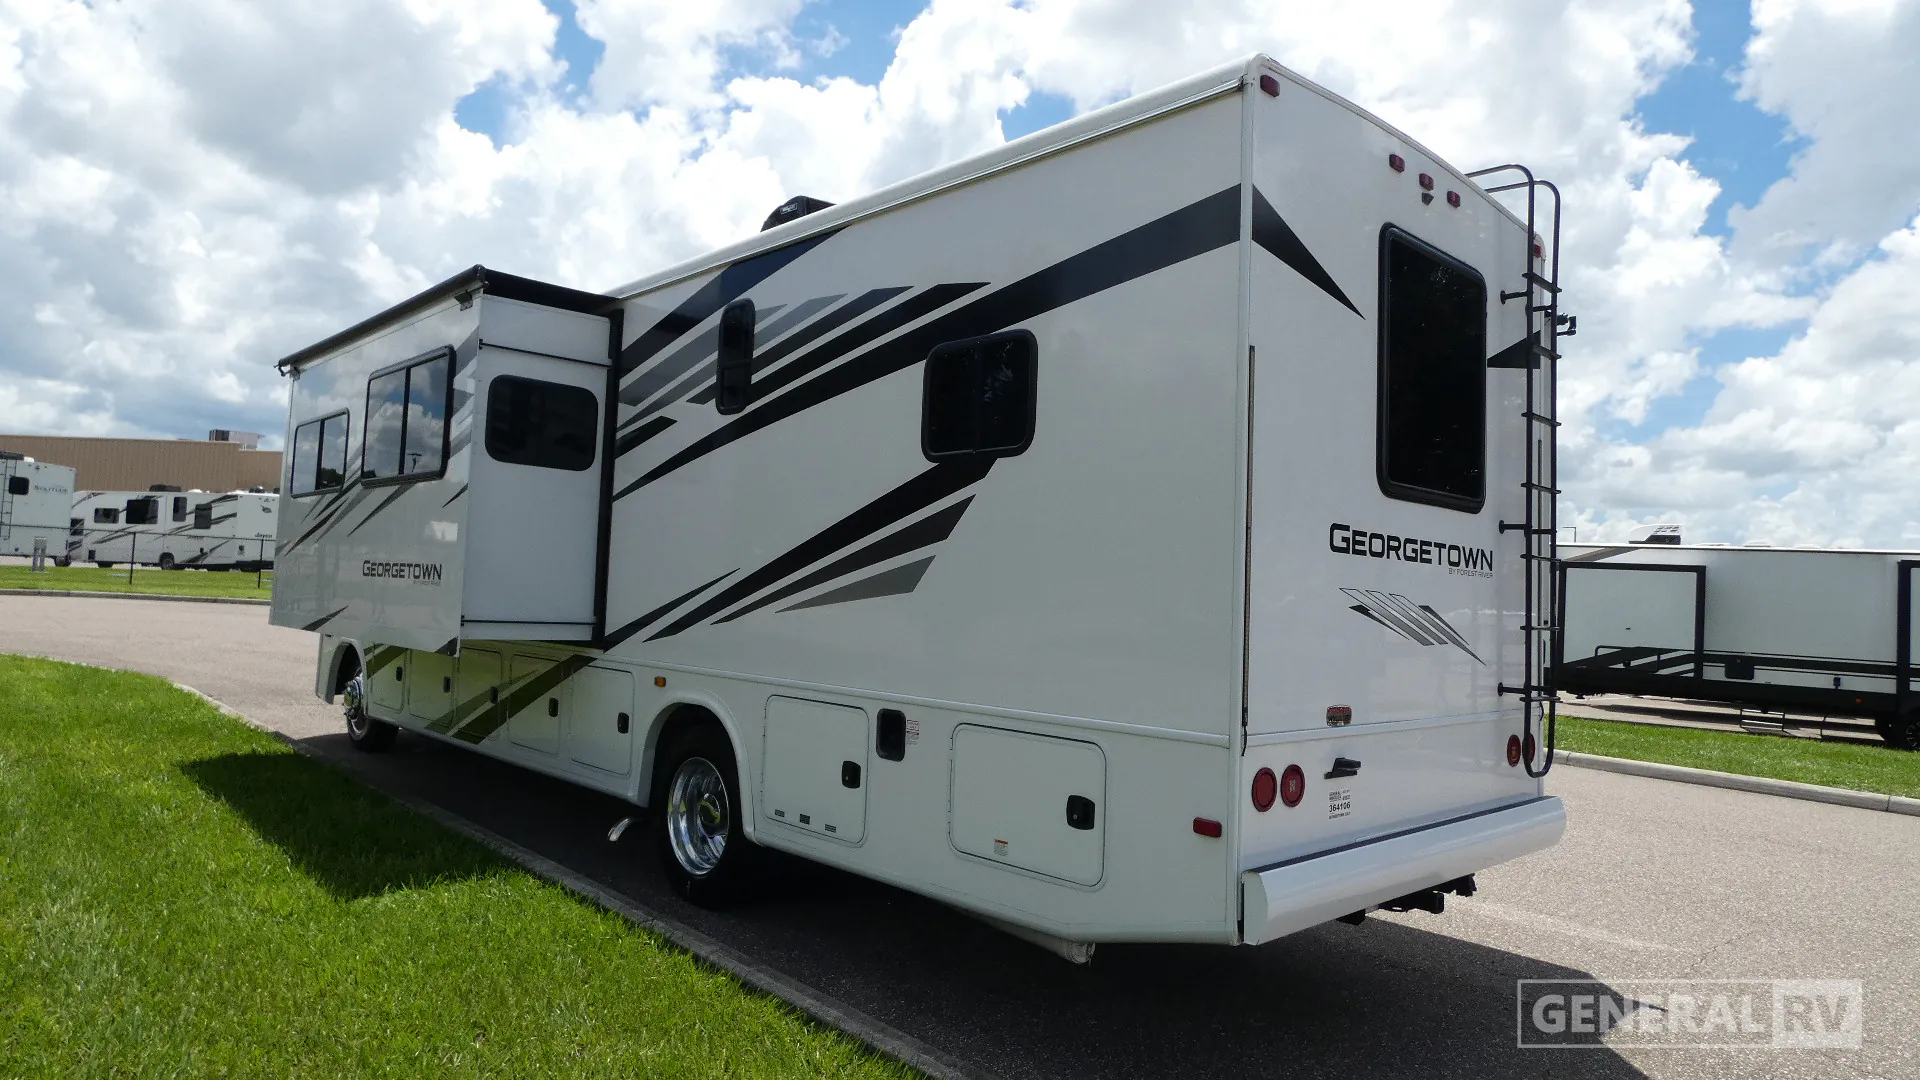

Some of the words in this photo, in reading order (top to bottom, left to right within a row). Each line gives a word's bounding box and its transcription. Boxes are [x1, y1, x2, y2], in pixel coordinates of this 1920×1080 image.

[1329, 522, 1493, 571] GEORGETOWN
[362, 560, 442, 580] GEORGETOWN
[1448, 567, 1456, 575] BY
[1457, 568, 1478, 577] FOREST
